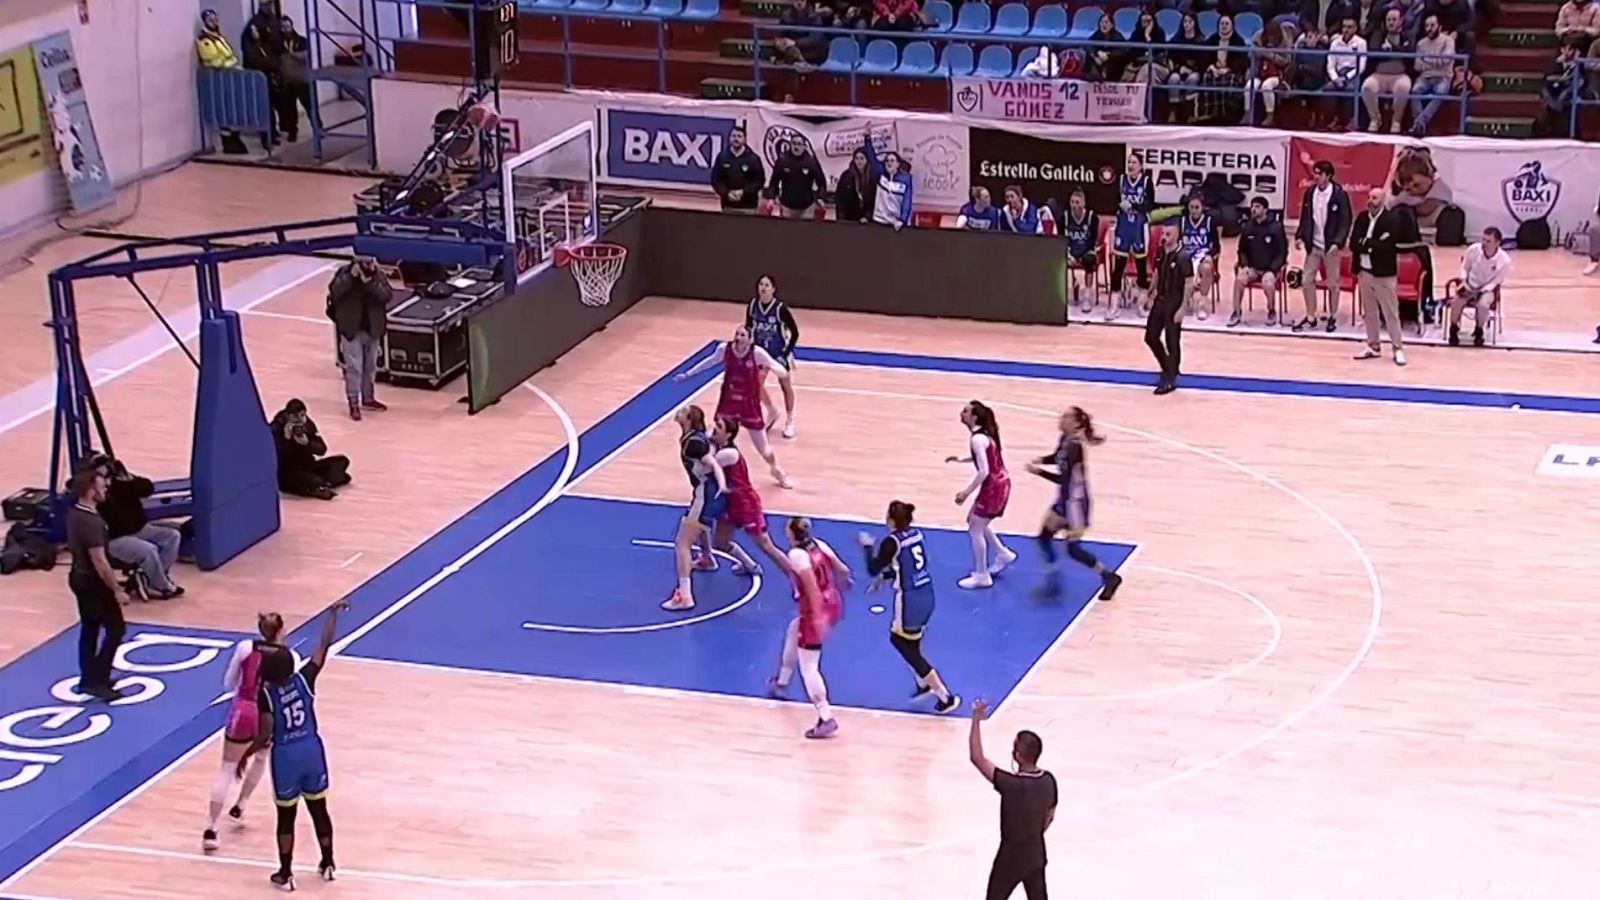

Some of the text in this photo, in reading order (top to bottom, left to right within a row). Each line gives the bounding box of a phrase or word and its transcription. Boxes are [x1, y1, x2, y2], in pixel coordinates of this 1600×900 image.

[987, 80, 1080, 100] VAMOS 12
[1005, 99, 1065, 119] GÓMEZ
[624, 127, 722, 168] BAXI
[980, 160, 1095, 183] Estrella Galicia
[1512, 189, 1550, 203] BAXI
[911, 545, 924, 570] 5
[283, 699, 306, 729] 15
